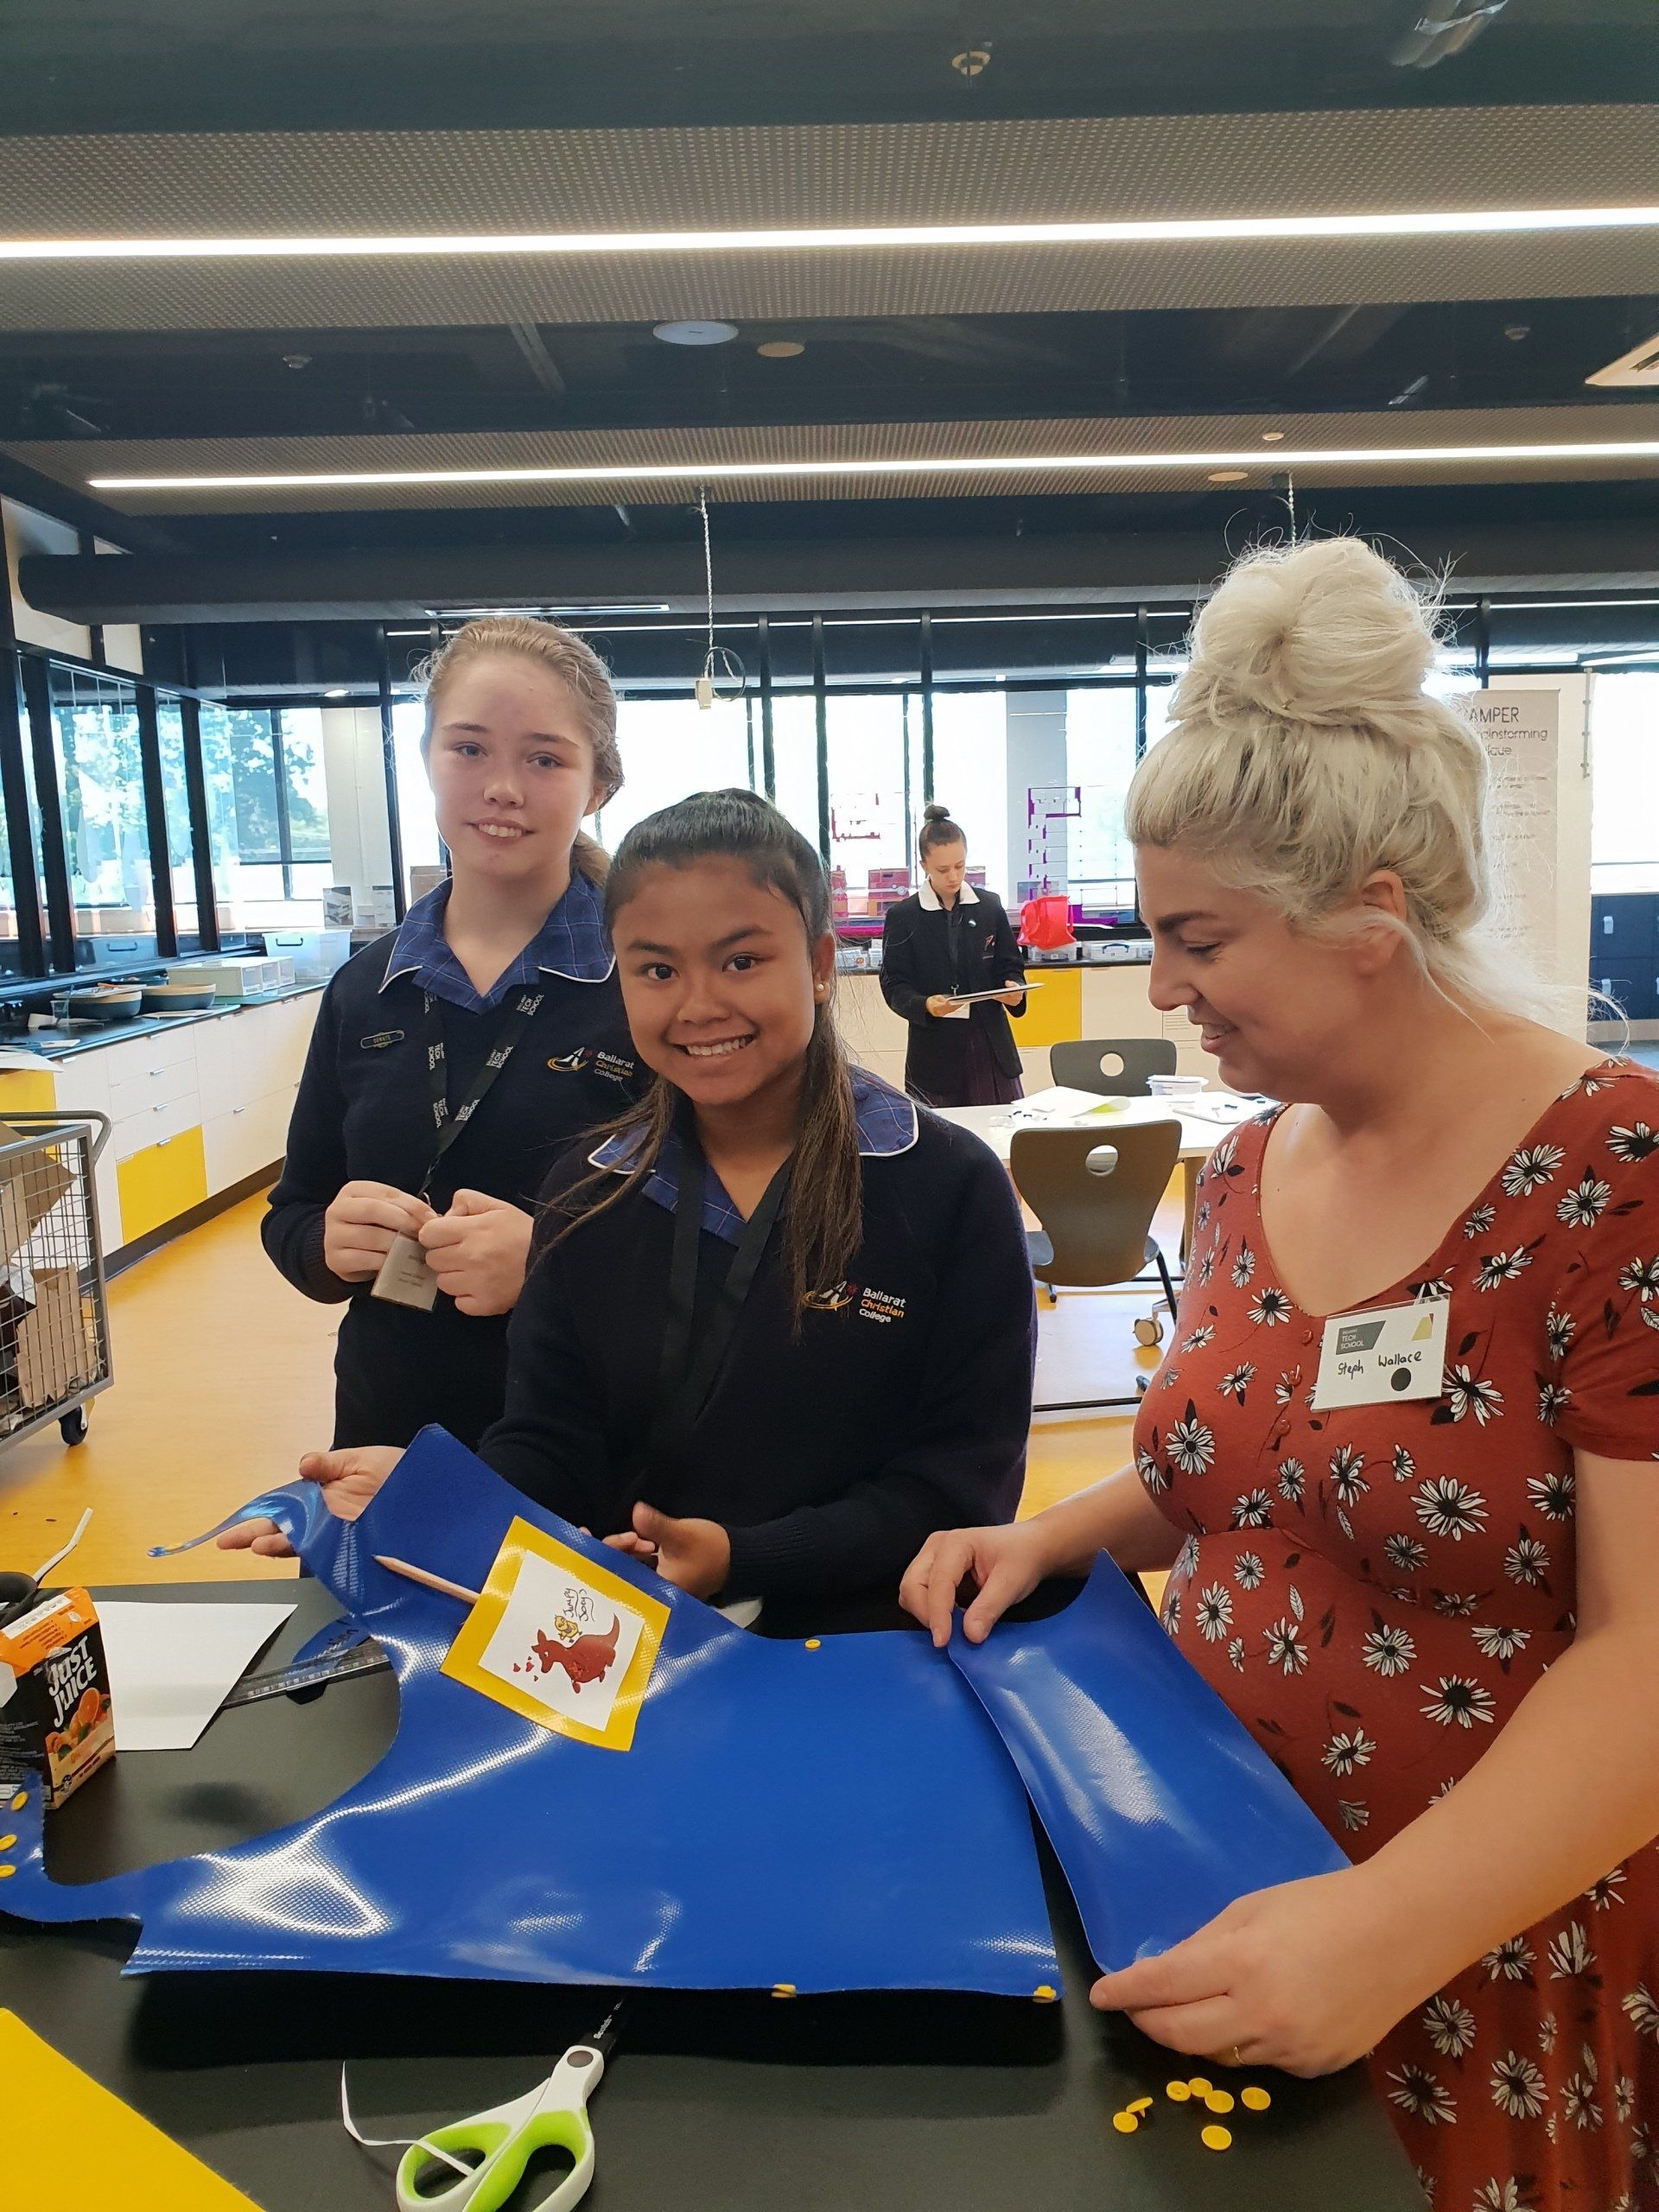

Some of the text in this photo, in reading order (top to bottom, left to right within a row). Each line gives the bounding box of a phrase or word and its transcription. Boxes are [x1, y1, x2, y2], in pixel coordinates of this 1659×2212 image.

[1465, 707, 1519, 723] AMPER
[520, 998, 532, 1013] TECH
[527, 995, 544, 1016] SCHOOL
[492, 1052, 503, 1067] TECH
[497, 1046, 513, 1069] SCHOOL
[597, 1051, 635, 1069] Ballarat
[594, 1068, 624, 1082] College
[433, 1103, 442, 1128] SCHOOL
[464, 1099, 480, 1122] SCHOOL
[862, 1287, 906, 1308] Ballarat
[859, 1308, 892, 1323] College
[861, 1299, 905, 1319] Christian
[1340, 1339, 1364, 1350] SCHOOL
[1338, 1351, 1422, 1380] Steph Wallace
[48, 1635, 88, 1697] JUST
[54, 1656, 98, 1728] JUICE
